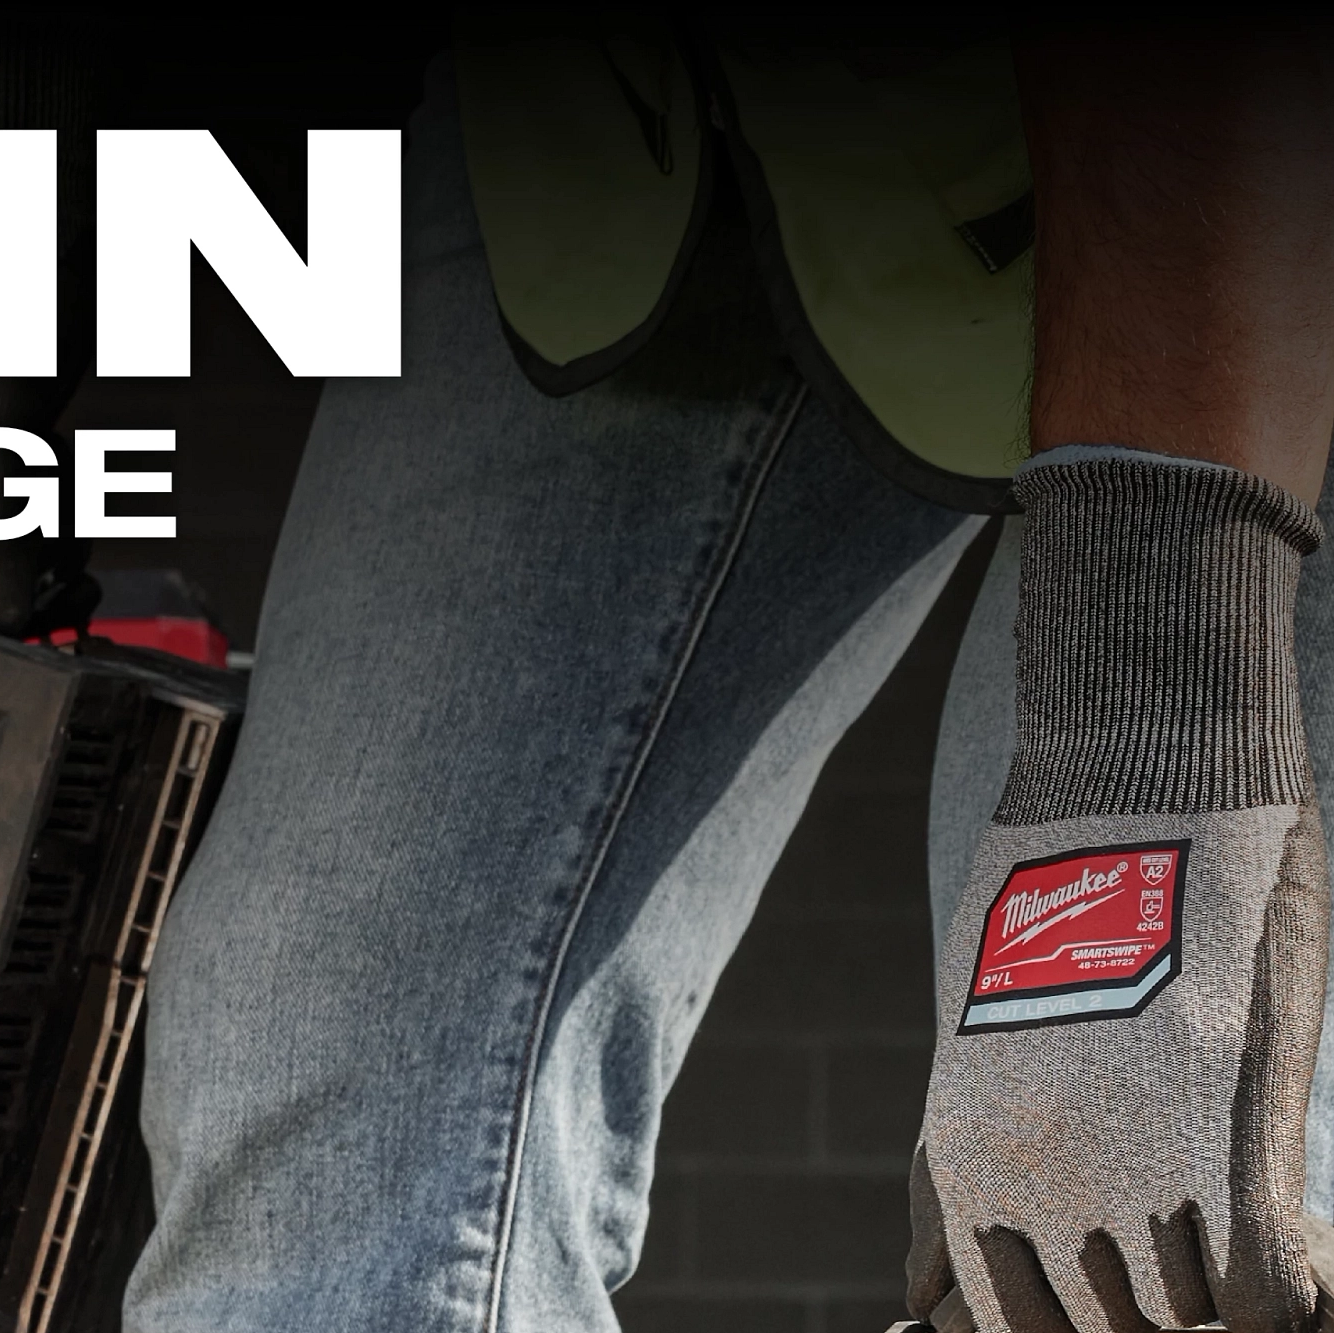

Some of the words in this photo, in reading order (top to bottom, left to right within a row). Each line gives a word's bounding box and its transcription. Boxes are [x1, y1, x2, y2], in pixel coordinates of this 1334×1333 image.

[1146, 865, 1164, 879] A2
[1136, 921, 1164, 932] 4242B
[987, 1005, 1021, 1020] CUT
[1026, 999, 1082, 1017] LEVEL
[1089, 995, 1102, 1008] 2
